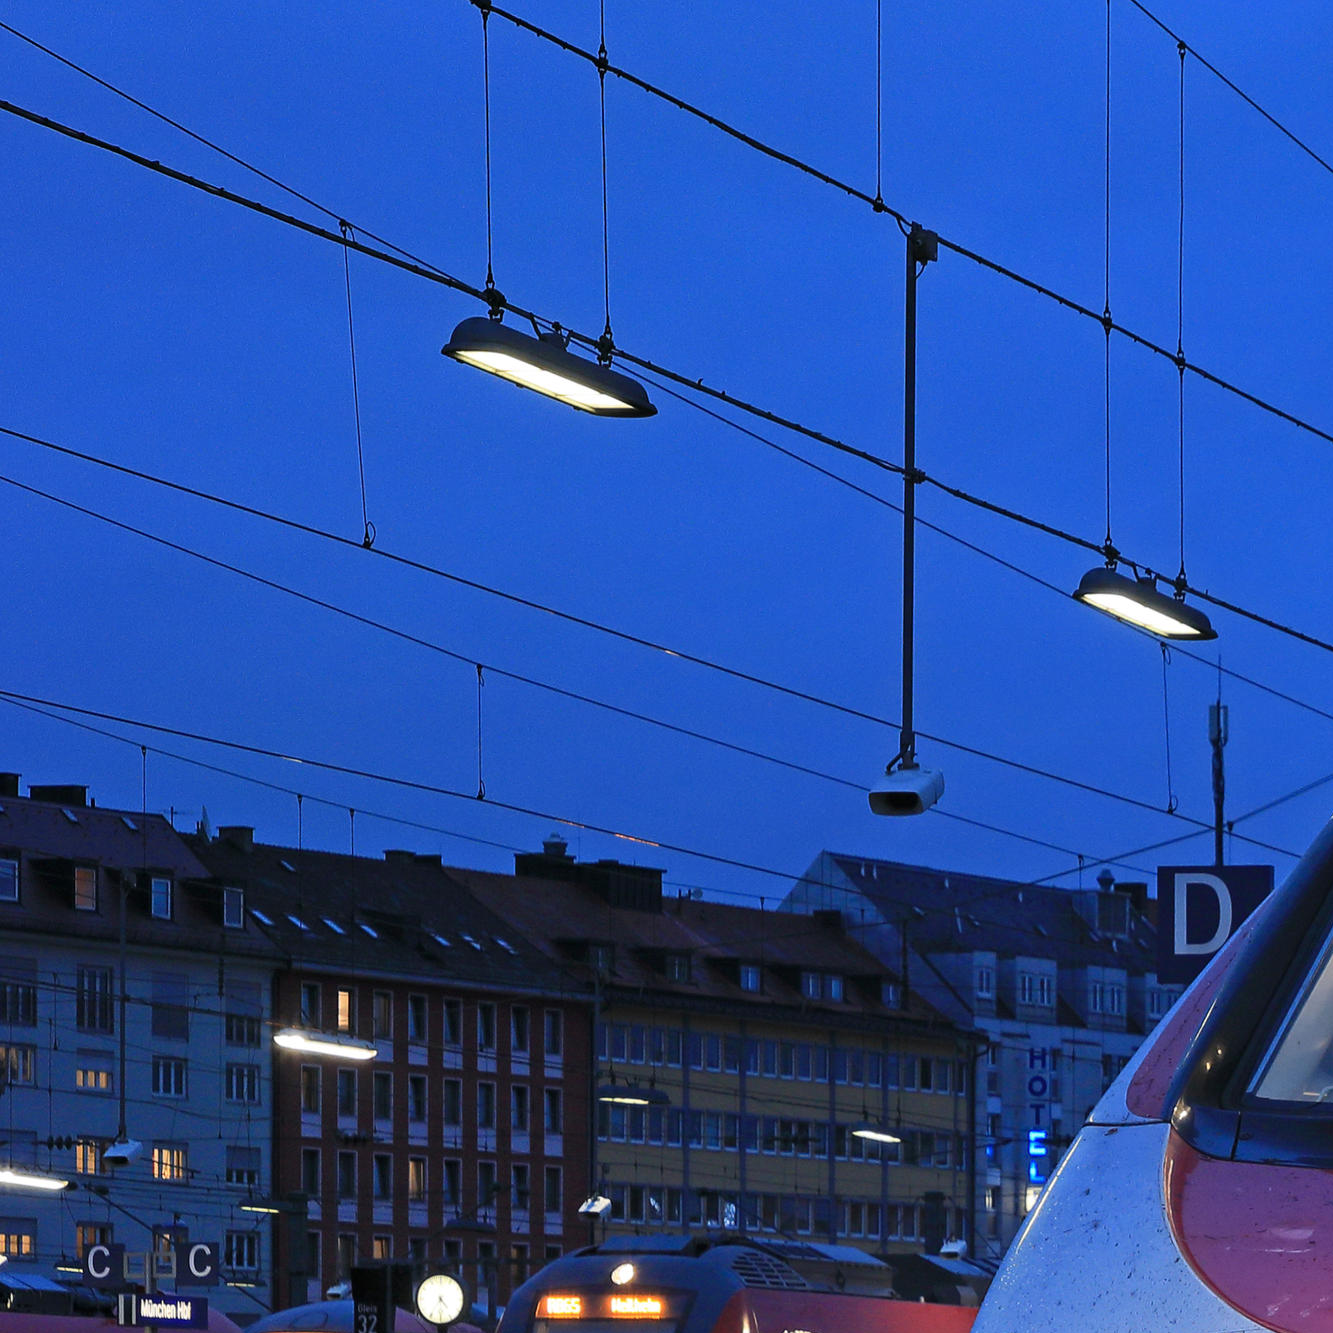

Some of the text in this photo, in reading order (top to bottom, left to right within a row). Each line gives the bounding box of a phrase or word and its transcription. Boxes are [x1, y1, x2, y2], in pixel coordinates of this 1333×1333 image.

[1174, 873, 1233, 956] D
[1028, 1047, 1048, 1184] HOTEL
[87, 1245, 111, 1279] C
[189, 1244, 212, 1278] C
[141, 1299, 191, 1320] München Hbf
